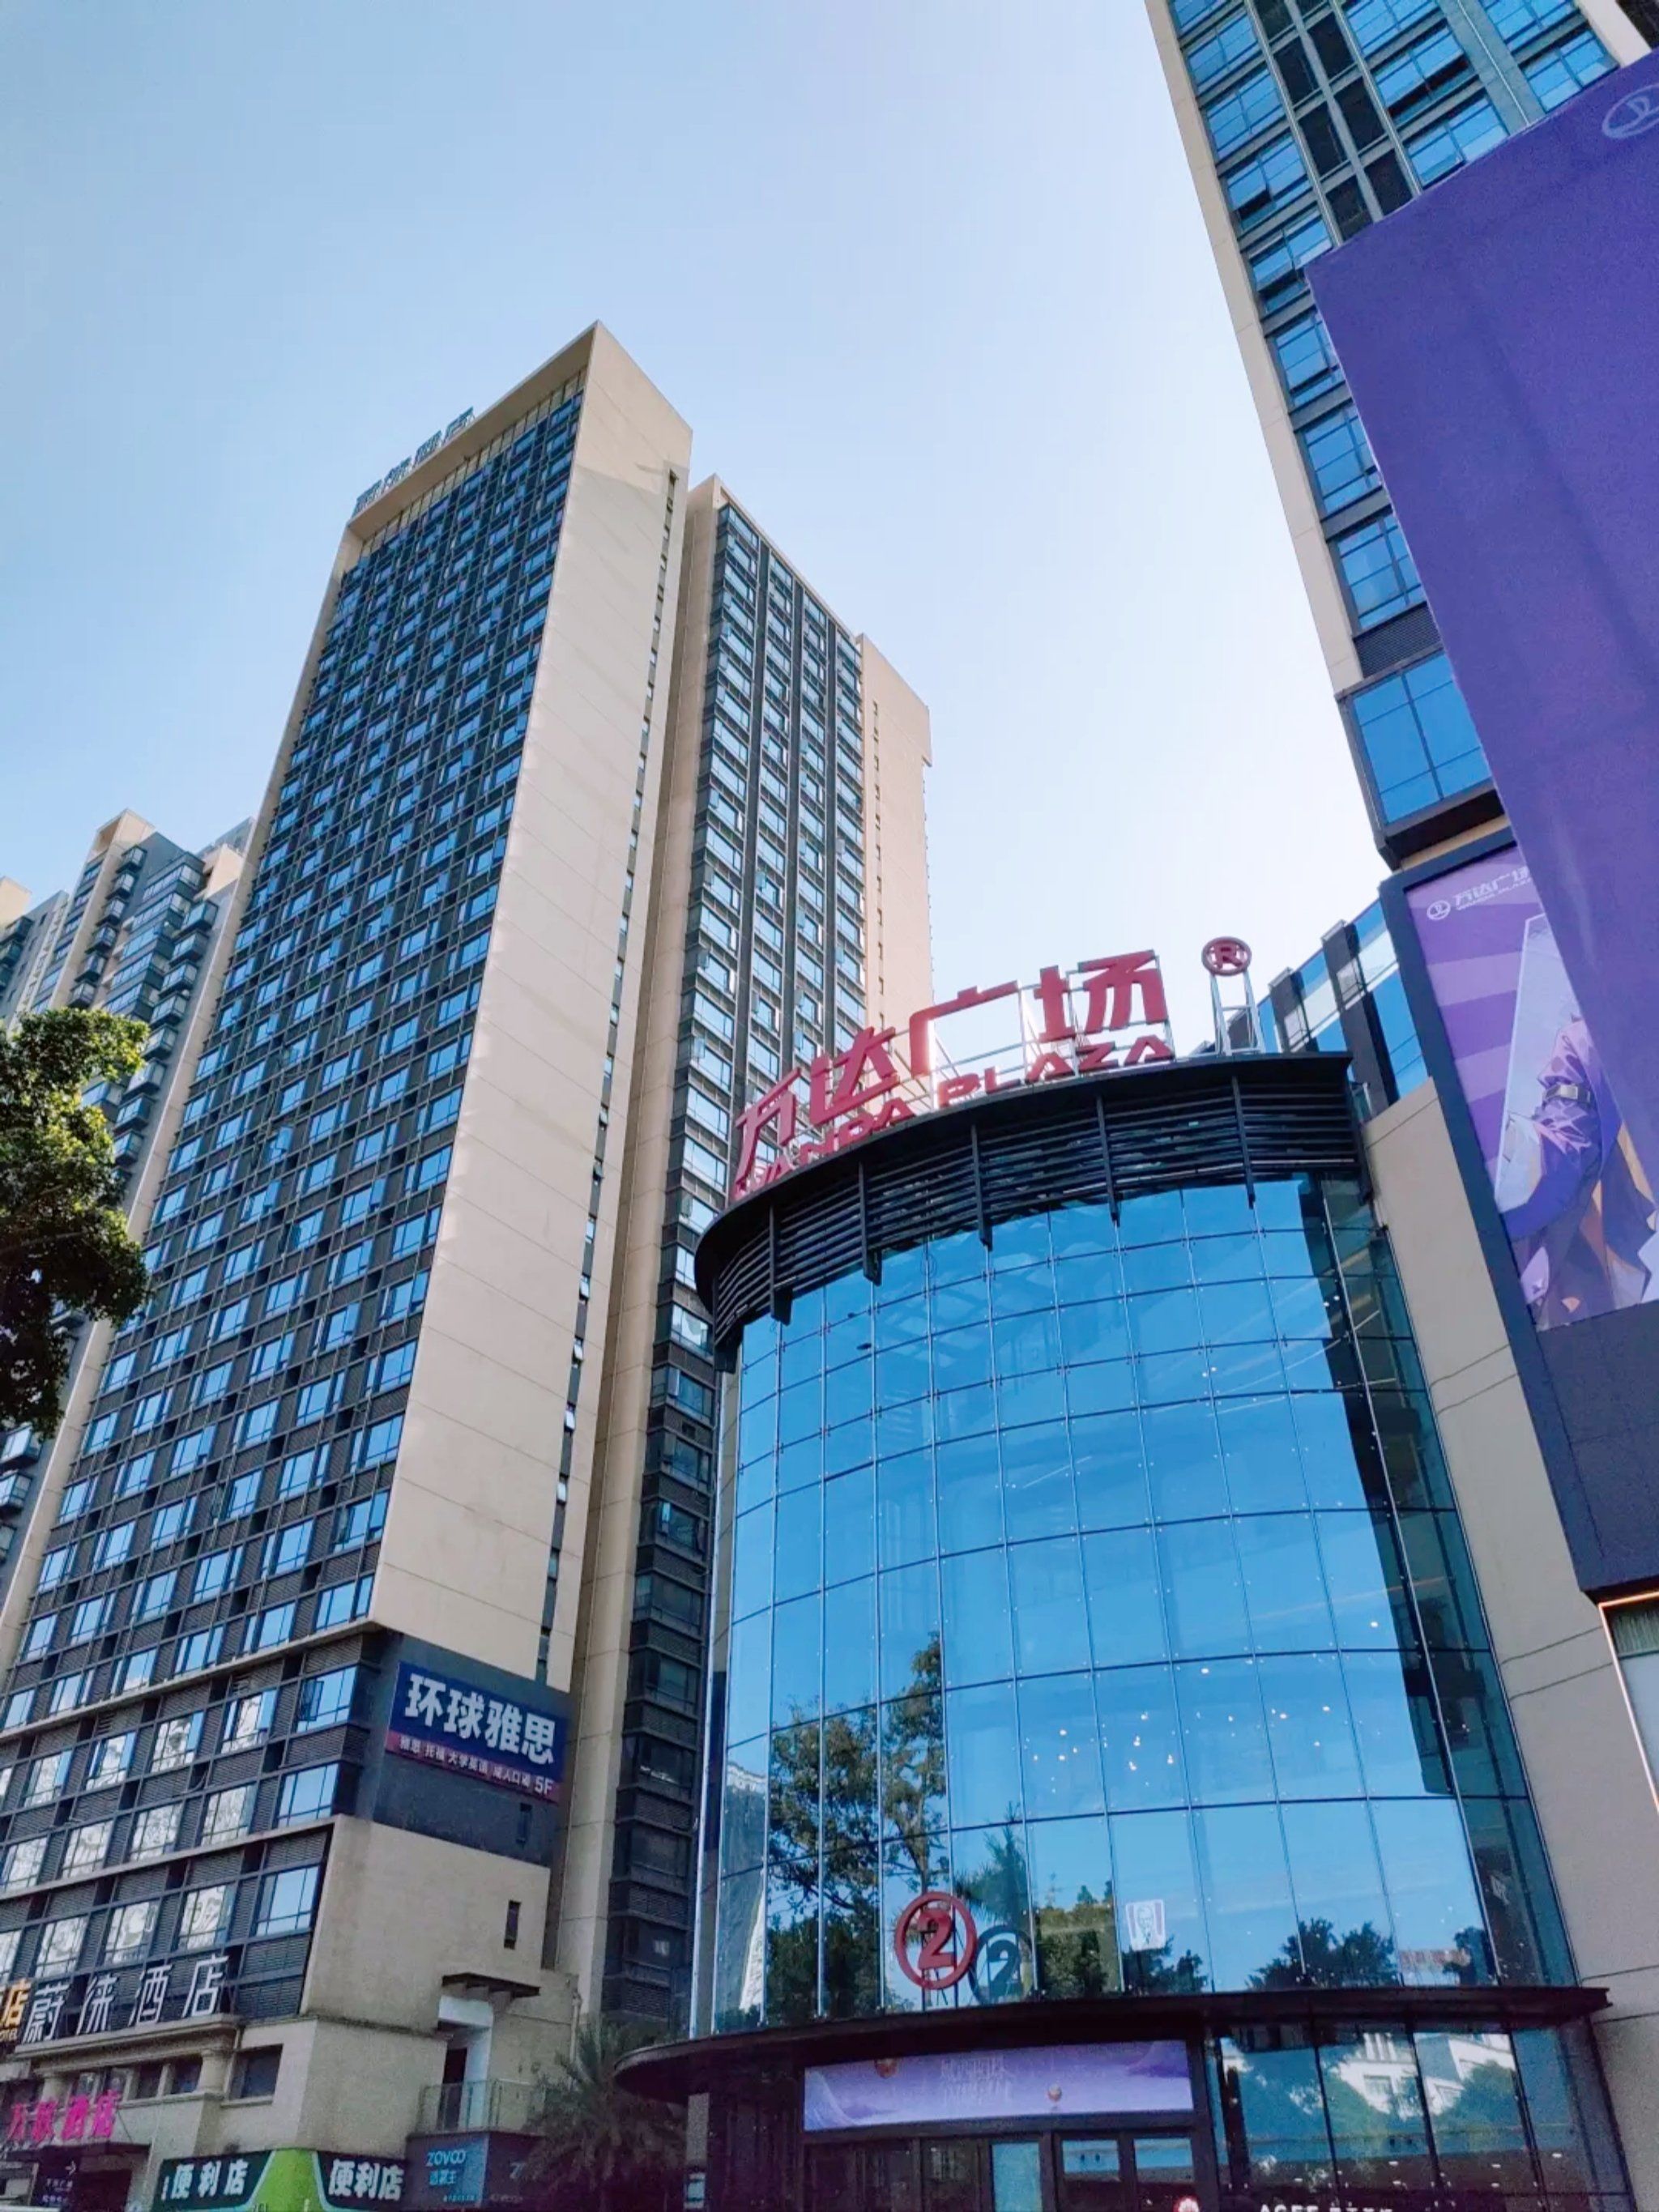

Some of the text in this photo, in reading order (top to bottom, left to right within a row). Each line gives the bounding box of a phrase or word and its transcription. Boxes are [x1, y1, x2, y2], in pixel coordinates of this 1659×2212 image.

[735, 949, 1169, 1184] 万达广场
[937, 1034, 1175, 1107] PLAZA
[405, 1673, 556, 1765] 环球雅思
[170, 2158, 249, 2201] 便利店
[328, 2158, 404, 2201] 便利店
